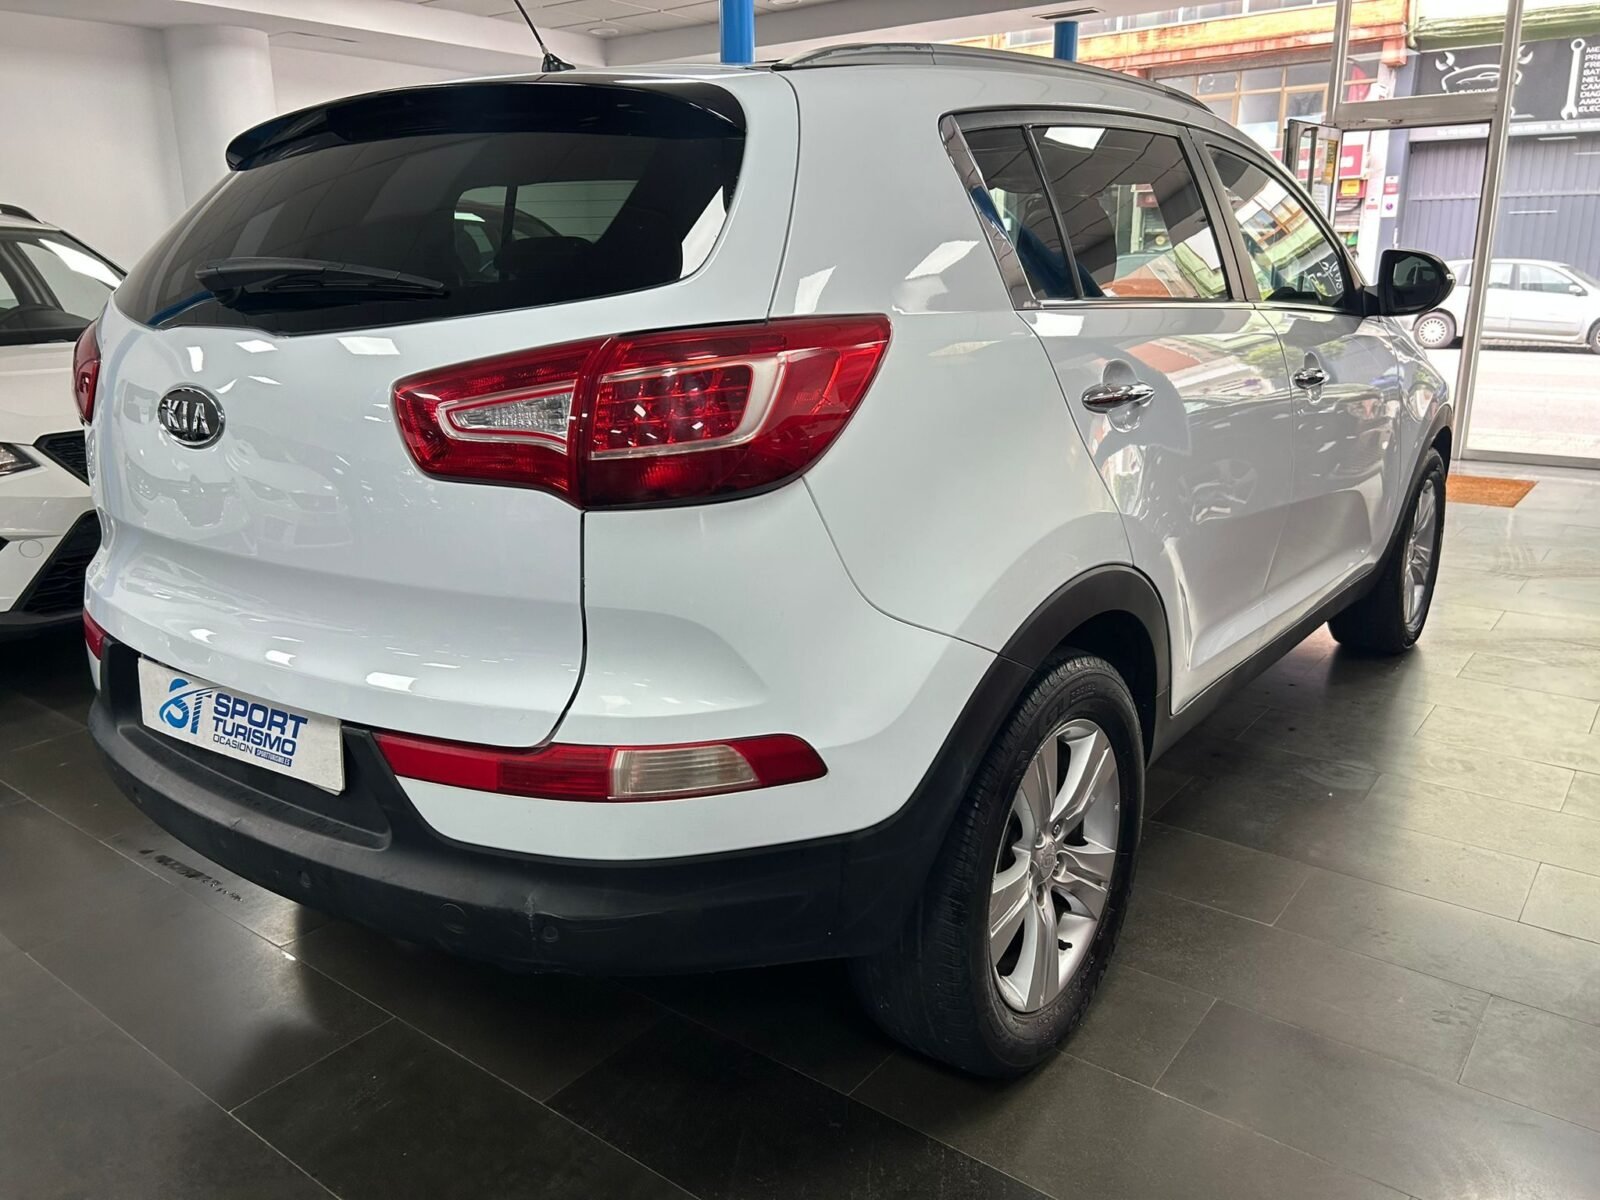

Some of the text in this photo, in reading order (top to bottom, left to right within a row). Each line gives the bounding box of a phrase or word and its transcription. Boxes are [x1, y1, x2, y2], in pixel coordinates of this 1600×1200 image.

[162, 399, 211, 434] KIA
[214, 693, 308, 739] SPORT
[213, 716, 296, 756] TURISMO
[213, 734, 253, 754] OCASION
